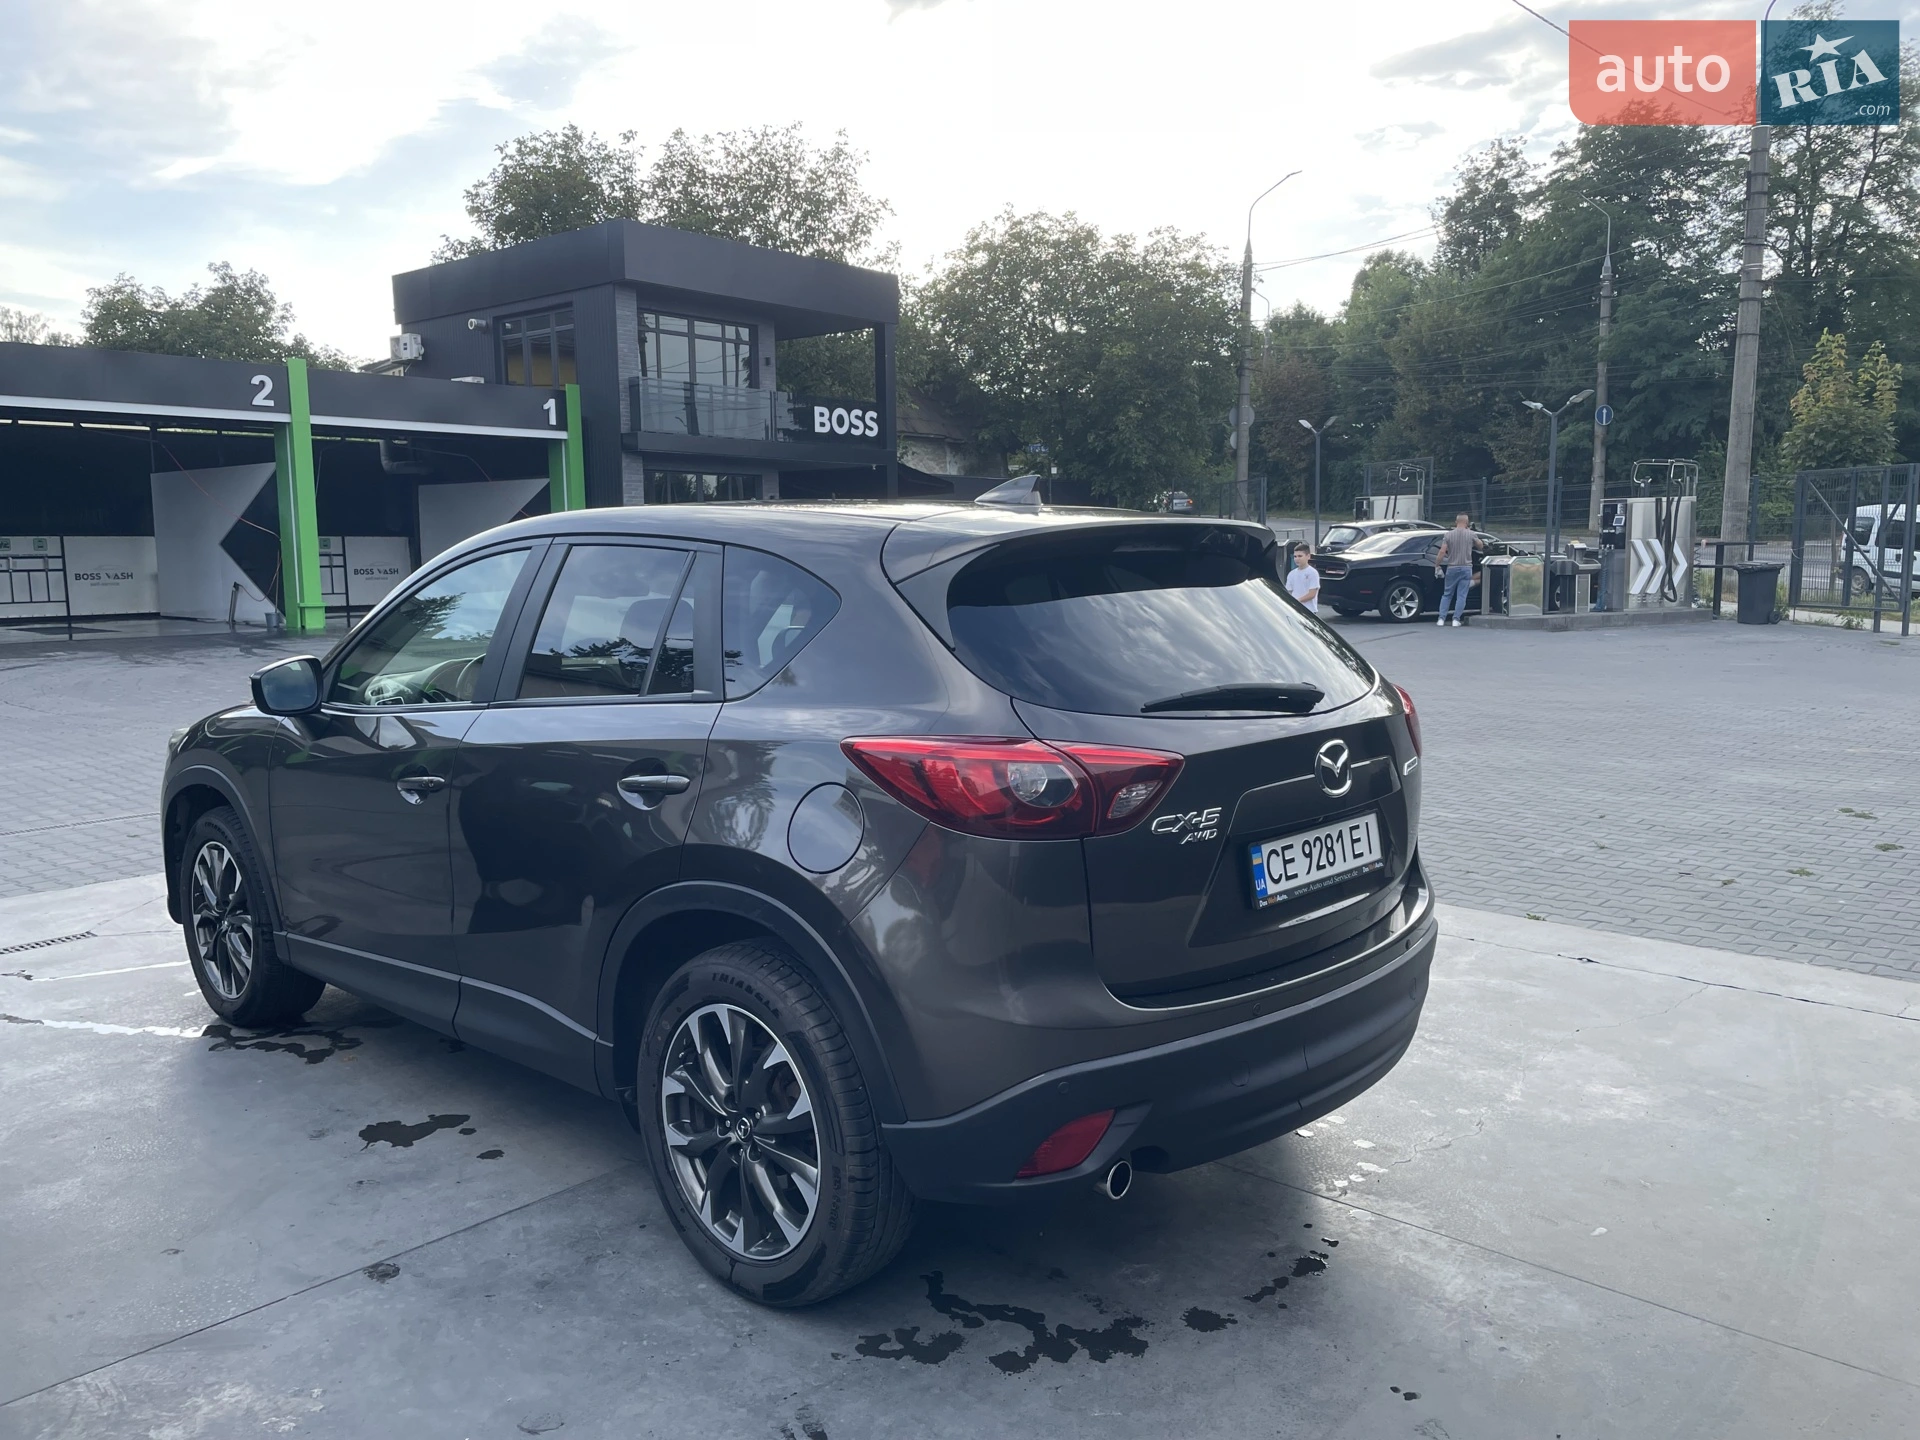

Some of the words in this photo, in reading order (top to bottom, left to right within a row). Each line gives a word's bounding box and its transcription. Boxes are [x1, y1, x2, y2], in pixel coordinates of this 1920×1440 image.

[250, 374, 275, 407] 2
[543, 398, 557, 426] 1
[814, 406, 879, 437] BOSS
[1151, 807, 1222, 835] CX-5
[1180, 829, 1218, 845] AWD
[1266, 843, 1299, 885] CE
[1301, 829, 1347, 875] 9281
[1349, 821, 1372, 860] EI
[1255, 878, 1266, 891] UA
